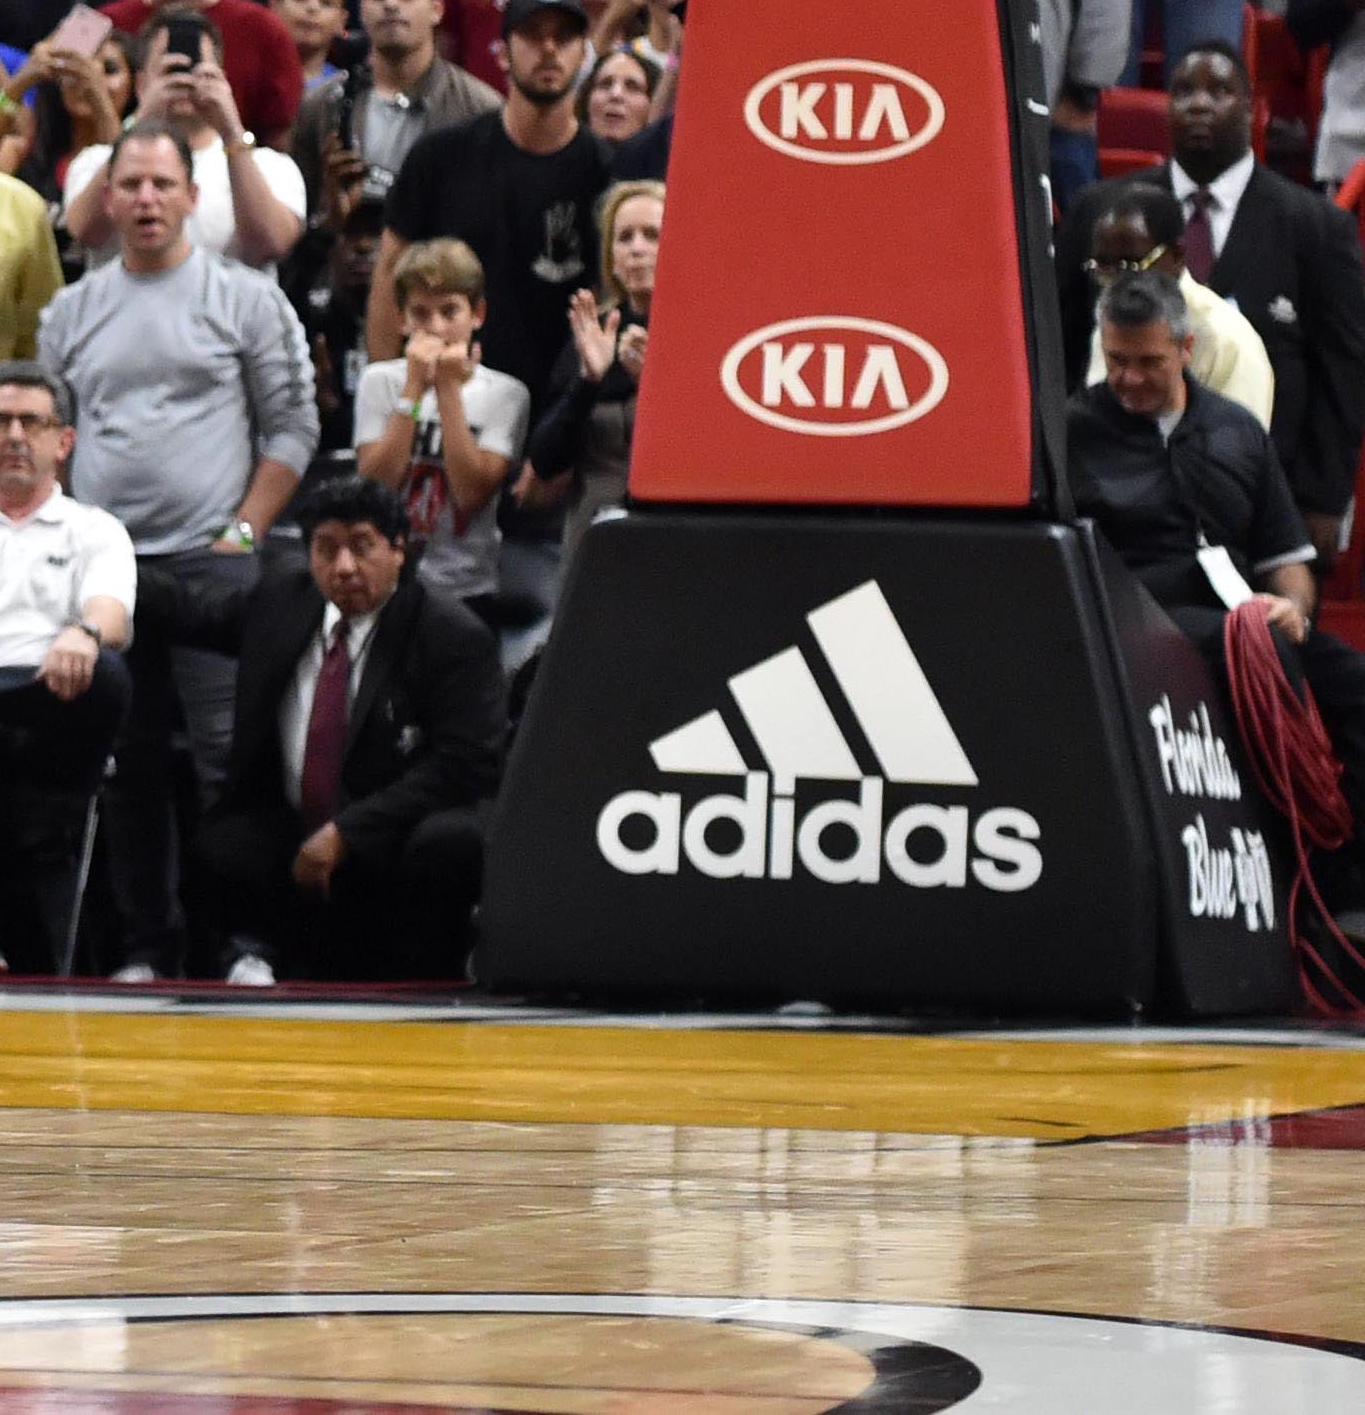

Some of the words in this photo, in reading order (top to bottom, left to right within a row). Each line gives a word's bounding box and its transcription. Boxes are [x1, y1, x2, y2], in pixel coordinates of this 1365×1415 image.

[780, 82, 912, 142] KIA
[761, 341, 910, 412] KIA
[597, 771, 1043, 893] adidas
[1181, 812, 1237, 919] Blue
